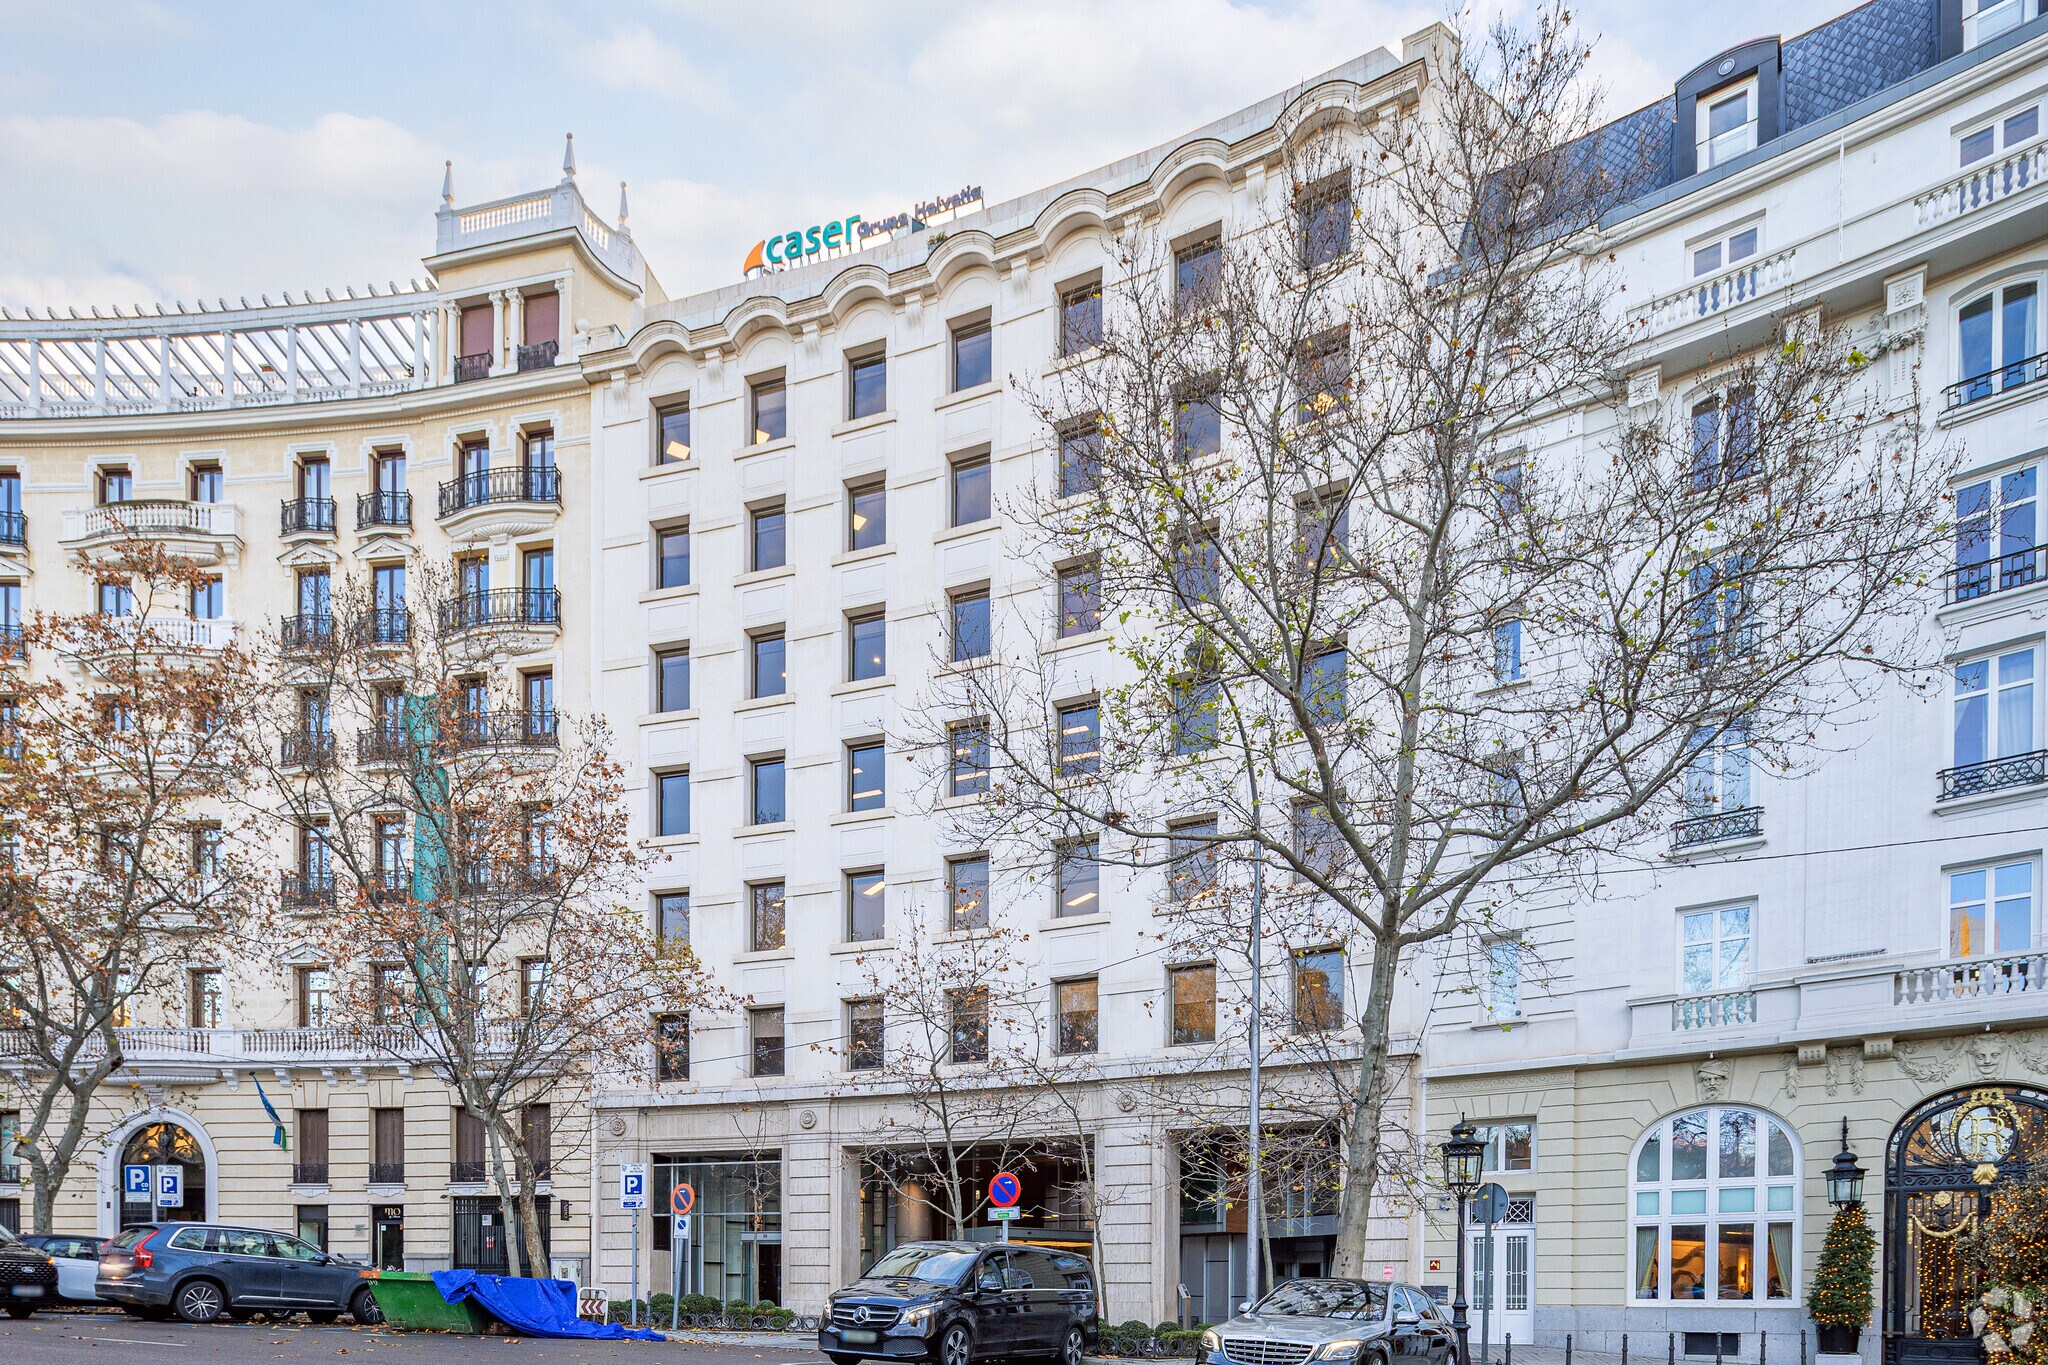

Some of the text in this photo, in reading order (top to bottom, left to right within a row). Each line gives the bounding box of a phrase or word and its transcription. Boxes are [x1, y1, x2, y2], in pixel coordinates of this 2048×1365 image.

[766, 214, 861, 263] caser
[914, 185, 983, 222] Helvetia
[130, 1169, 145, 1190] P
[163, 1177, 174, 1192] P
[627, 1176, 638, 1193] P
